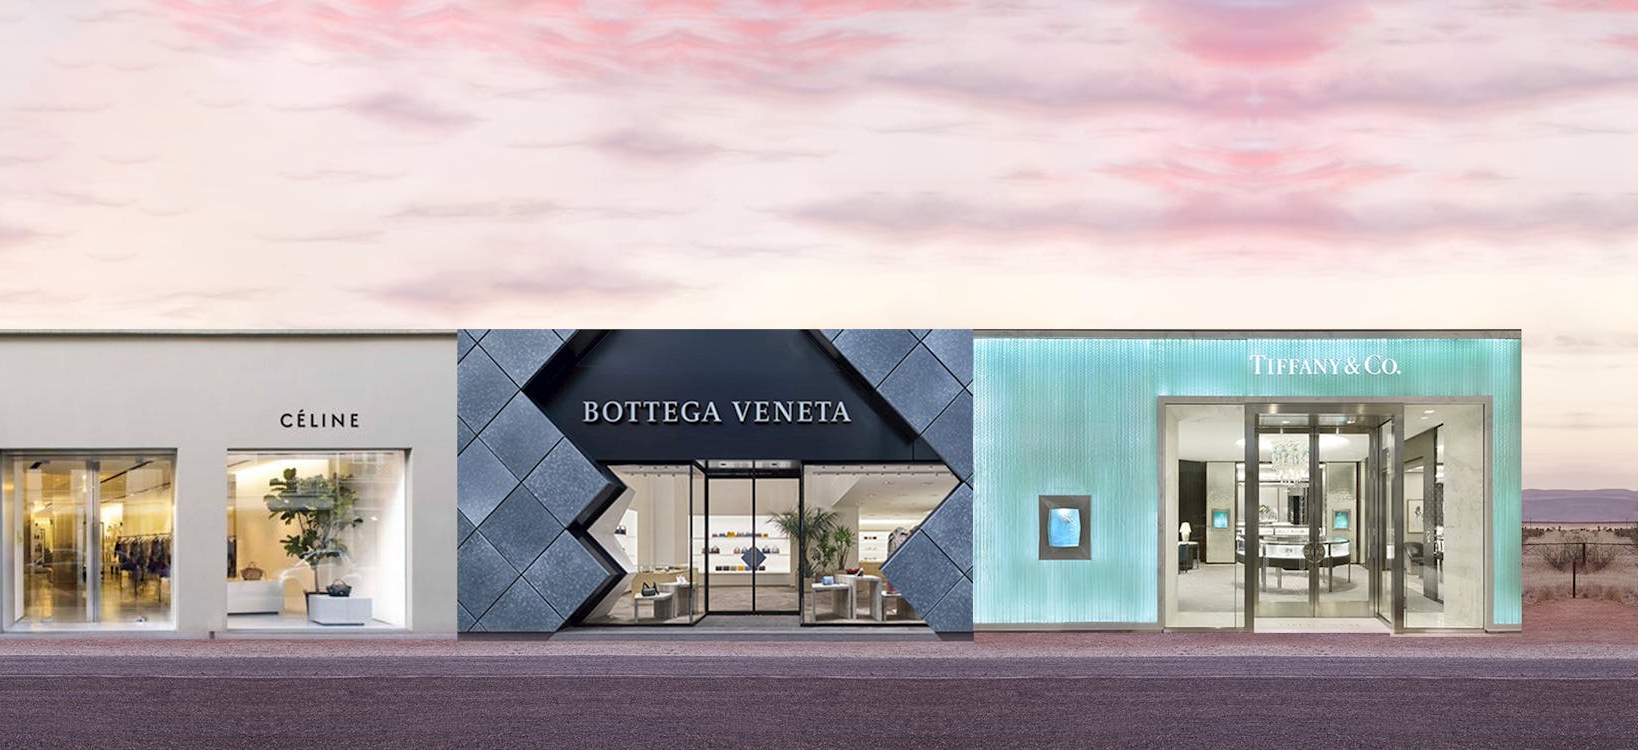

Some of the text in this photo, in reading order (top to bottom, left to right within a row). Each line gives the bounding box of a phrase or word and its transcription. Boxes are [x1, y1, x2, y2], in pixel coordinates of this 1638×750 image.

[1344, 356, 1360, 375] &
[280, 409, 359, 428] CÉLINE
[583, 400, 852, 423] BOTTEGA VENETA
